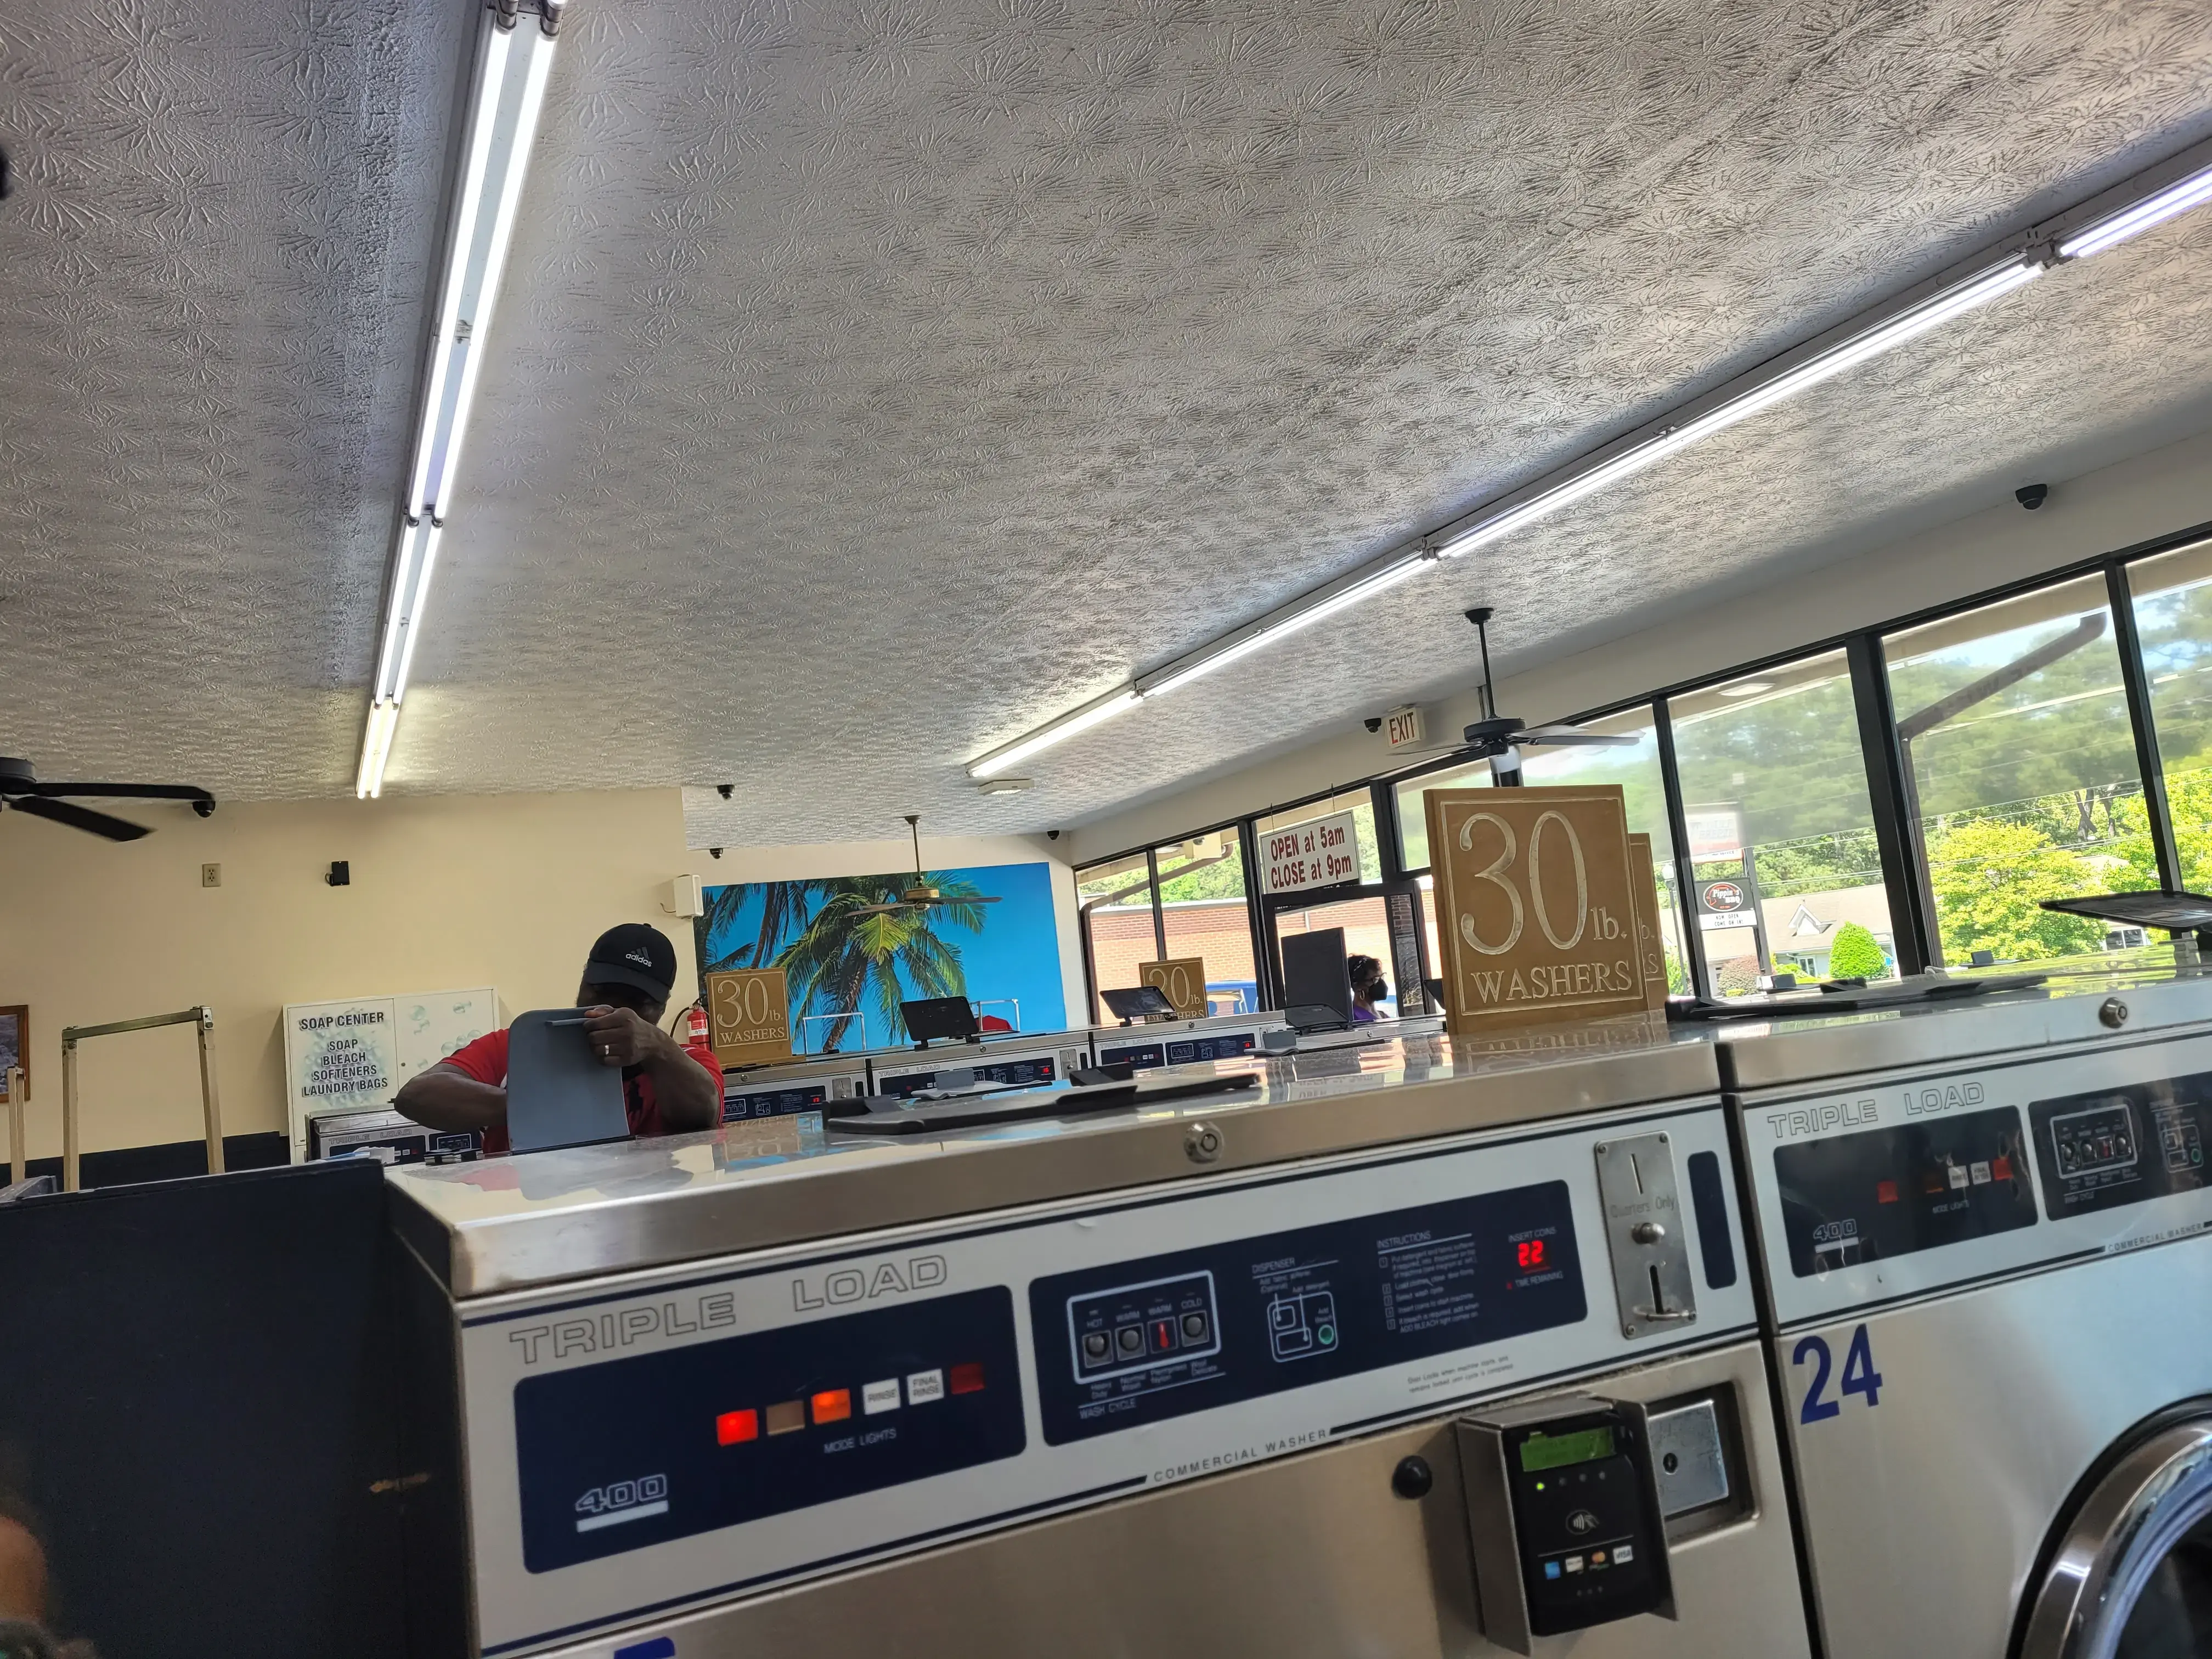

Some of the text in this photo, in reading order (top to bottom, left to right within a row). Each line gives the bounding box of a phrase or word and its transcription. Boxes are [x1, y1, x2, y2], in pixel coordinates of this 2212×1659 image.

[1389, 712, 1415, 744] EXIT
[1271, 826, 1345, 861] OPEN at 5am
[1271, 854, 1352, 889] CLOSE at 9pm
[1460, 810, 1628, 955] 30 lb.
[625, 953, 652, 967] adidas
[1471, 961, 1632, 1003] WASHERS
[716, 978, 784, 1028] 30 lb.
[300, 1012, 384, 1030] SOAP CENTER
[329, 1039, 358, 1051] SOAP
[720, 1028, 785, 1043] WASHERS
[323, 1052, 366, 1065] BLEACH
[313, 1065, 377, 1081] SOFTENERS
[878, 1068, 909, 1077] TRIPLE
[303, 1077, 388, 1096] LAUNDRY BAGS
[1767, 1082, 1984, 1138] TRIPLE LOAD
[329, 1129, 412, 1145] TRIPLE LOAD
[1656, 1195, 1674, 1211] Only
[1376, 1230, 1431, 1248] INSTRUCTIONS
[1813, 1218, 1858, 1242] 400
[2108, 1223, 2202, 1252] COMMERCIAL WASHER
[1519, 1240, 1543, 1266] 22
[1252, 1257, 1295, 1274] DISPENSER
[510, 1255, 947, 1364] TRIPLE LOAD
[1181, 1298, 1202, 1309] COLD
[912, 1376, 938, 1386] FINAL
[1792, 1323, 1883, 1425] 24
[868, 1388, 897, 1402] RINSE
[912, 1385, 939, 1397] RINSE
[1079, 1399, 1137, 1420] WASH CYCLE
[824, 1427, 896, 1453] MODE LIGHTS
[1154, 1429, 1326, 1482] COMMERCIAL WASHER
[575, 1474, 667, 1513] 400
[1616, 1550, 1630, 1559] VISA
